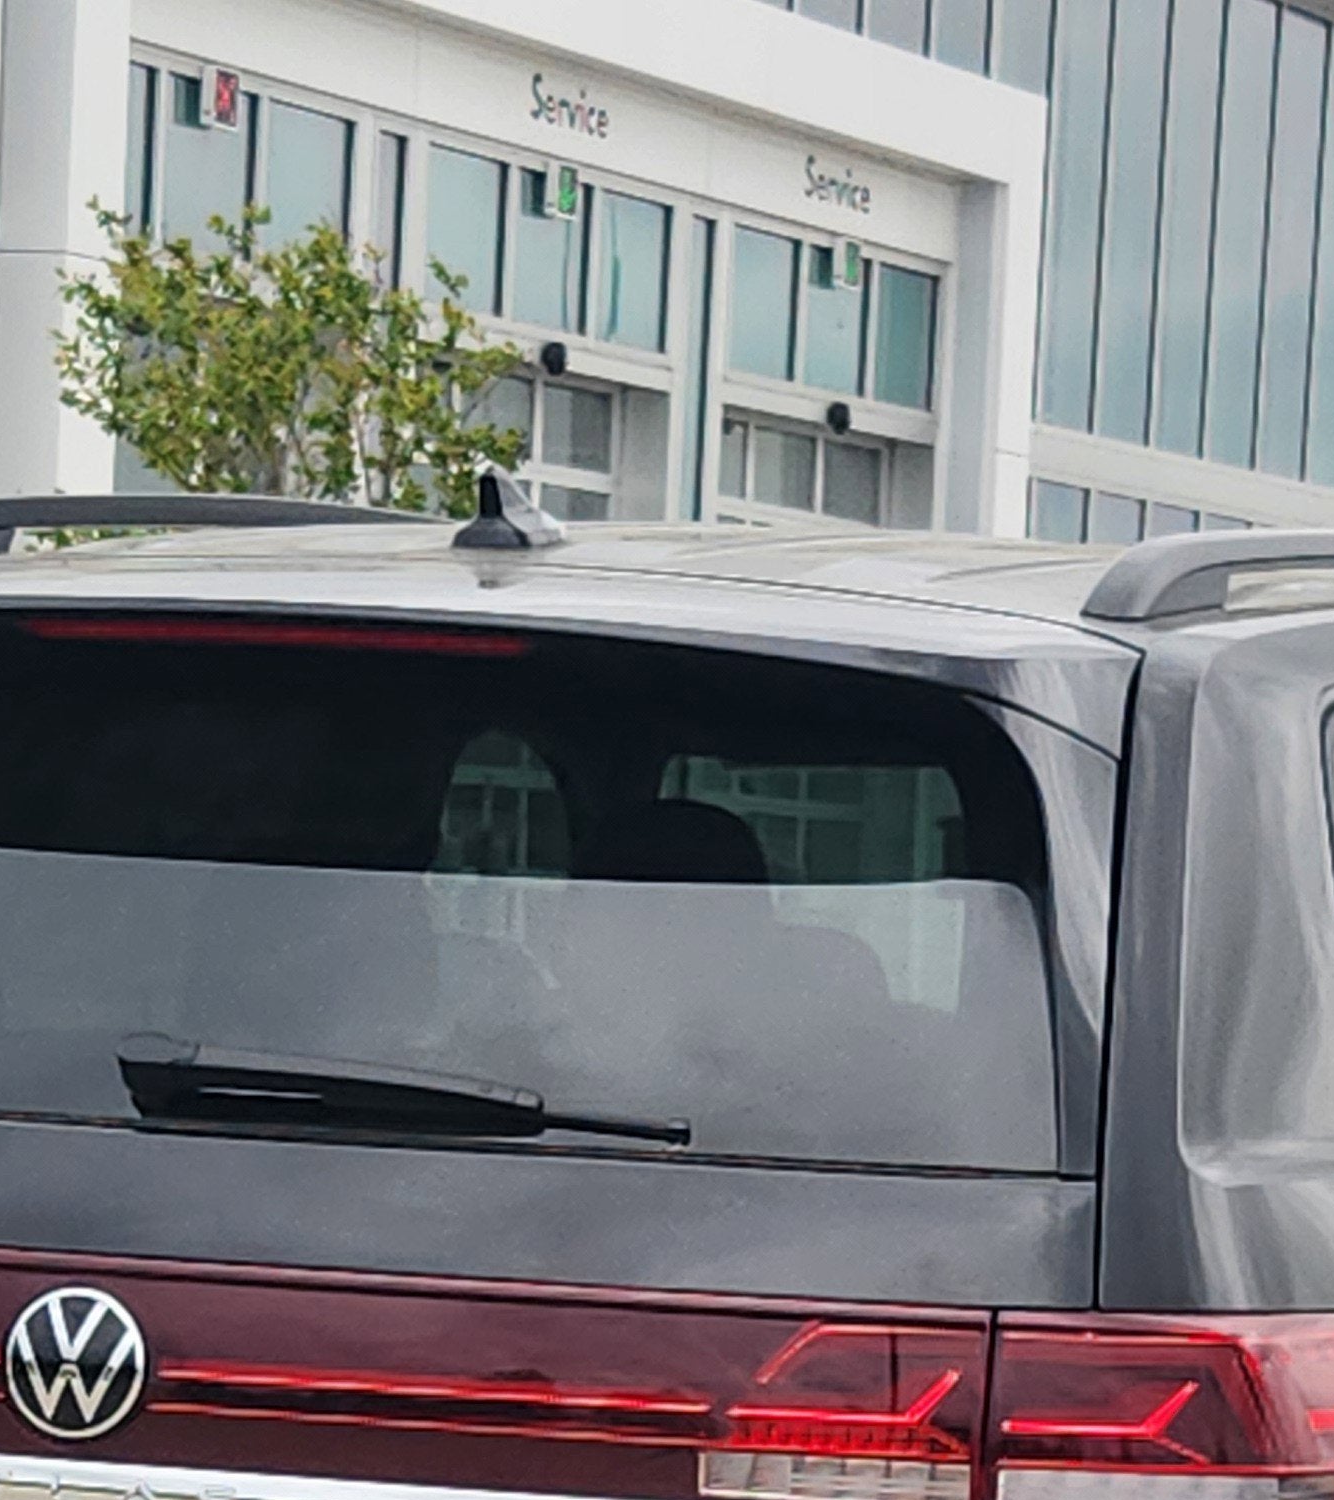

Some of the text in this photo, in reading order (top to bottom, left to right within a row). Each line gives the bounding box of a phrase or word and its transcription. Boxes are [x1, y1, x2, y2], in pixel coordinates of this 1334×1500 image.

[530, 72, 609, 138] Service
[803, 154, 870, 214] Service
[9, 1289, 143, 1434] VW
